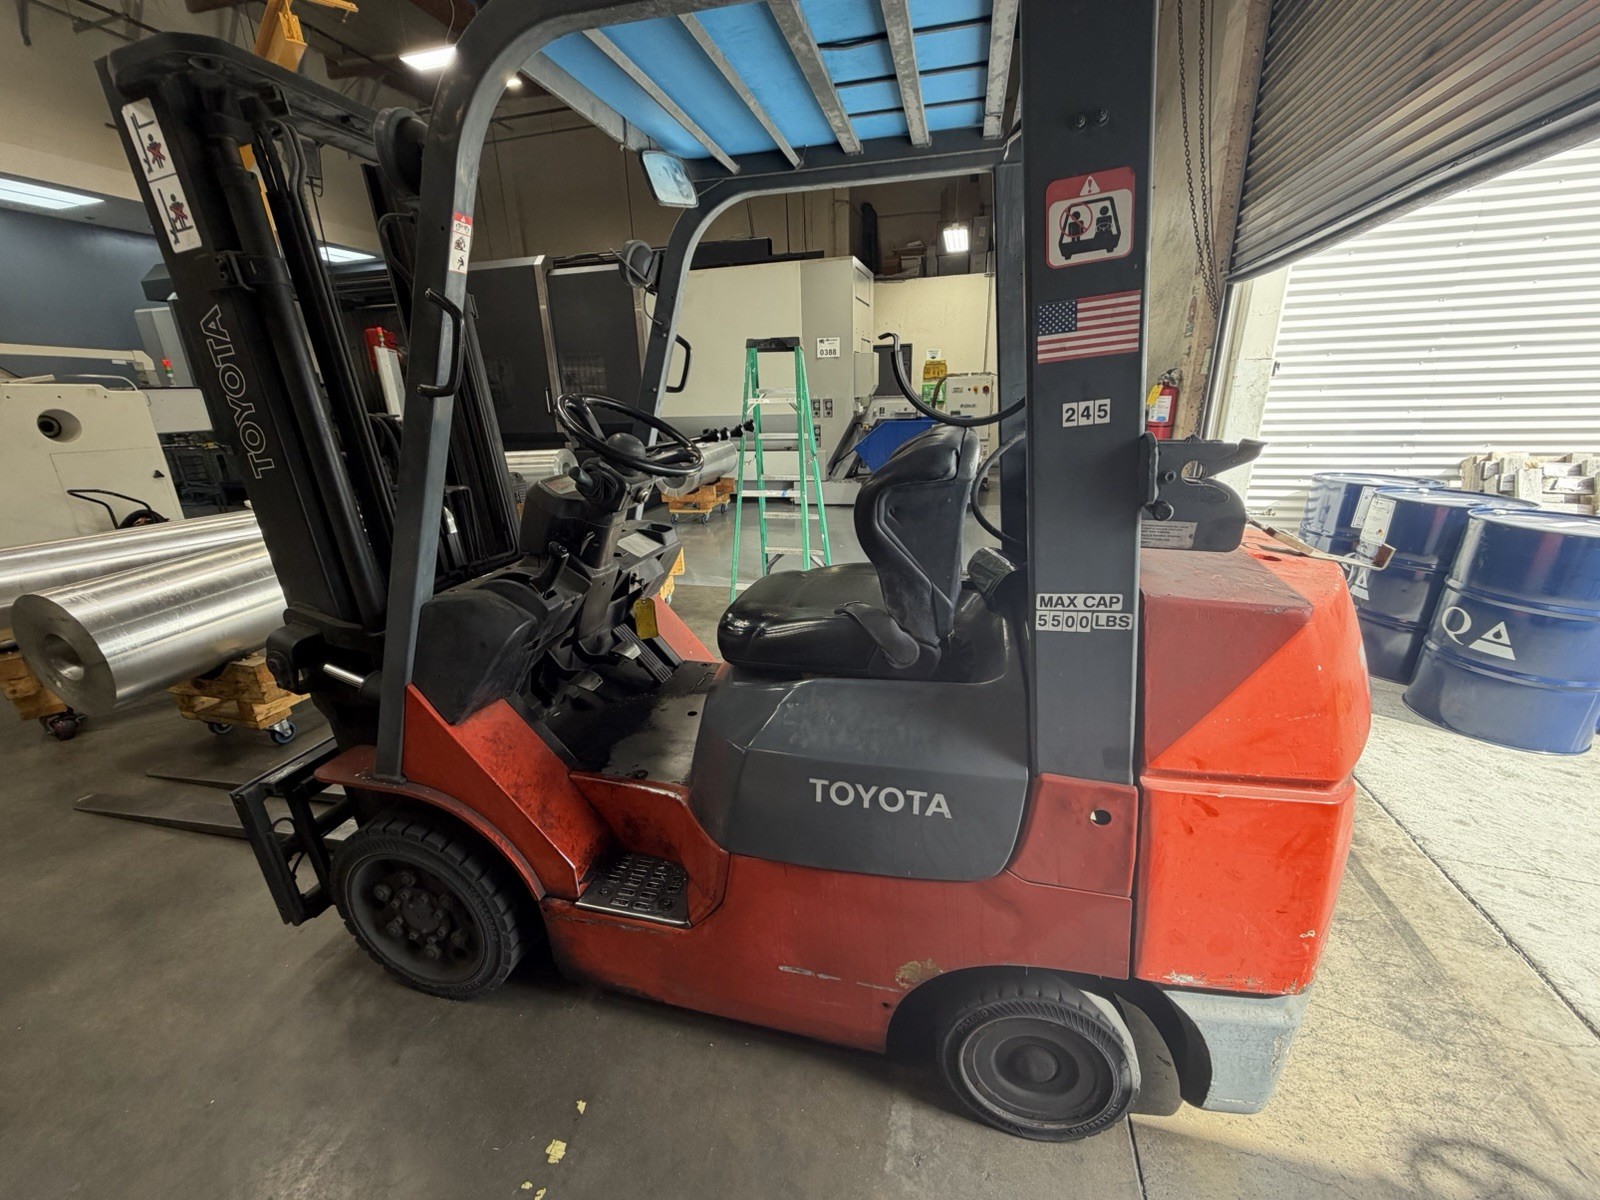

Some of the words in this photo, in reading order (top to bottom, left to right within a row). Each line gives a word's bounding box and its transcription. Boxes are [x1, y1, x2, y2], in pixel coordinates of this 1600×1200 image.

[819, 348, 837, 356] 0388
[200, 304, 275, 479] TOYOTA
[1064, 403, 1108, 423] 245
[1039, 595, 1078, 608] MAX
[1083, 595, 1120, 608] CAP
[1037, 614, 1090, 629] 5500
[1095, 615, 1130, 628] LBS
[808, 777, 952, 819] TOYOTA
